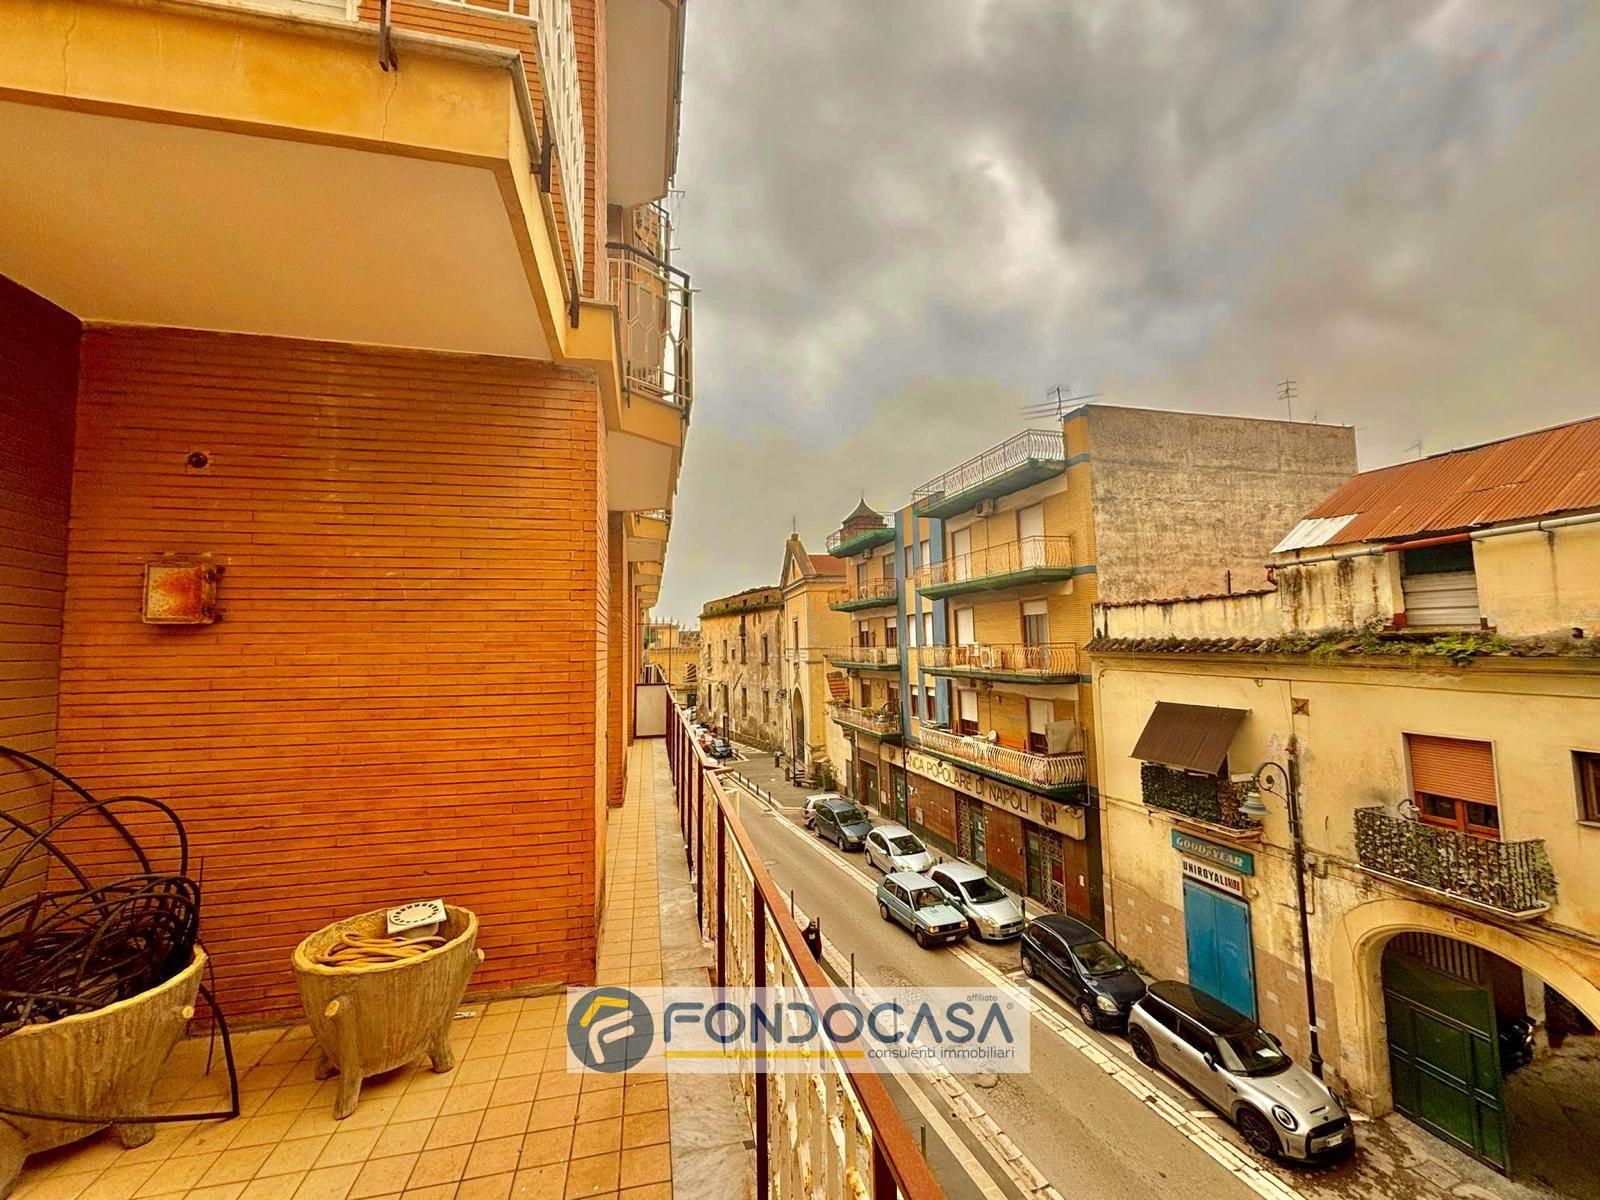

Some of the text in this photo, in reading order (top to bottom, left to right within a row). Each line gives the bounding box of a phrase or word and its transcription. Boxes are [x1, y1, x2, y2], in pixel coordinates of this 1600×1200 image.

[926, 759, 972, 791] POPOLARE
[975, 778, 985, 797] DI
[989, 785, 1029, 814] NAPOLI
[1176, 837, 1244, 867] GOODYEAR
[1183, 861, 1225, 886] UNIROYAL
